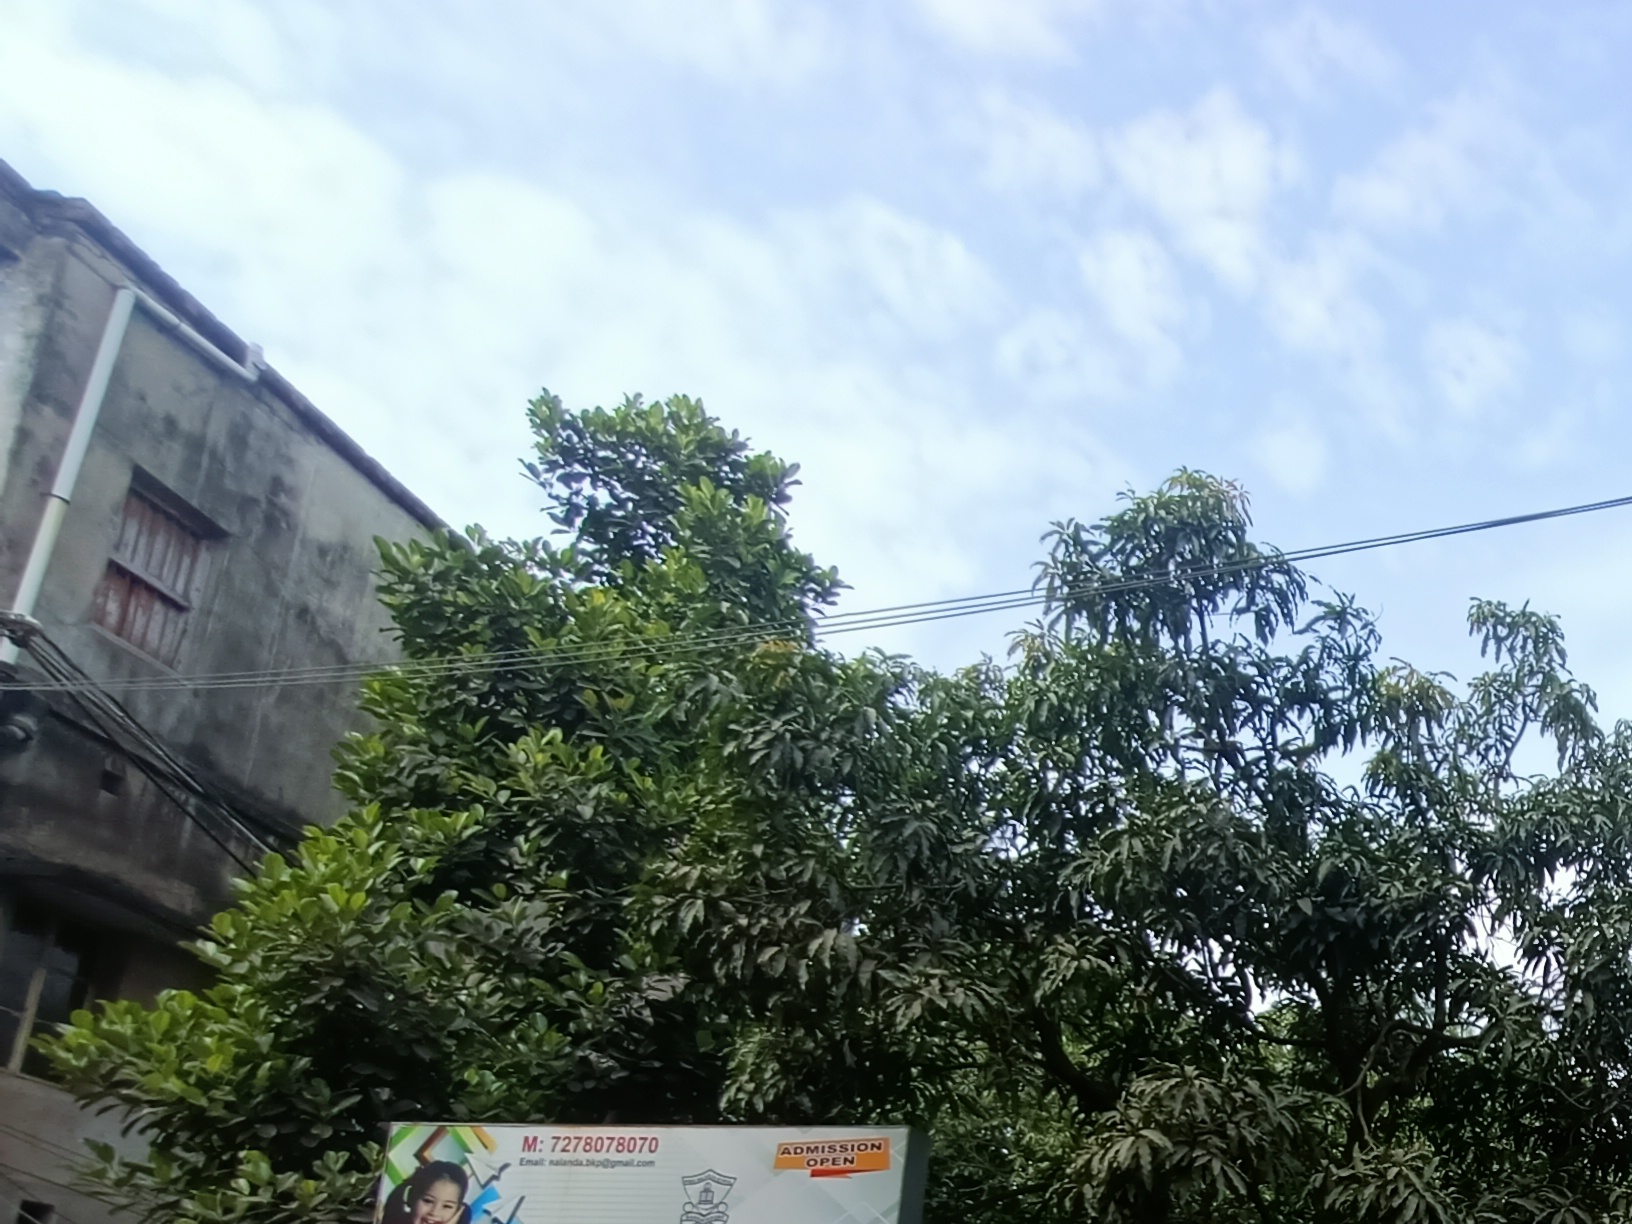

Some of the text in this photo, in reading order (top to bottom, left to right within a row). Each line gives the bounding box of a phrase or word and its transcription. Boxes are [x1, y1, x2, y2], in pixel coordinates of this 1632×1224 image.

[521, 1135, 659, 1154] M: 7278078070
[780, 1142, 882, 1156] ADMISSION
[519, 1158, 547, 1167] Email:
[806, 1156, 855, 1168] OPEN
